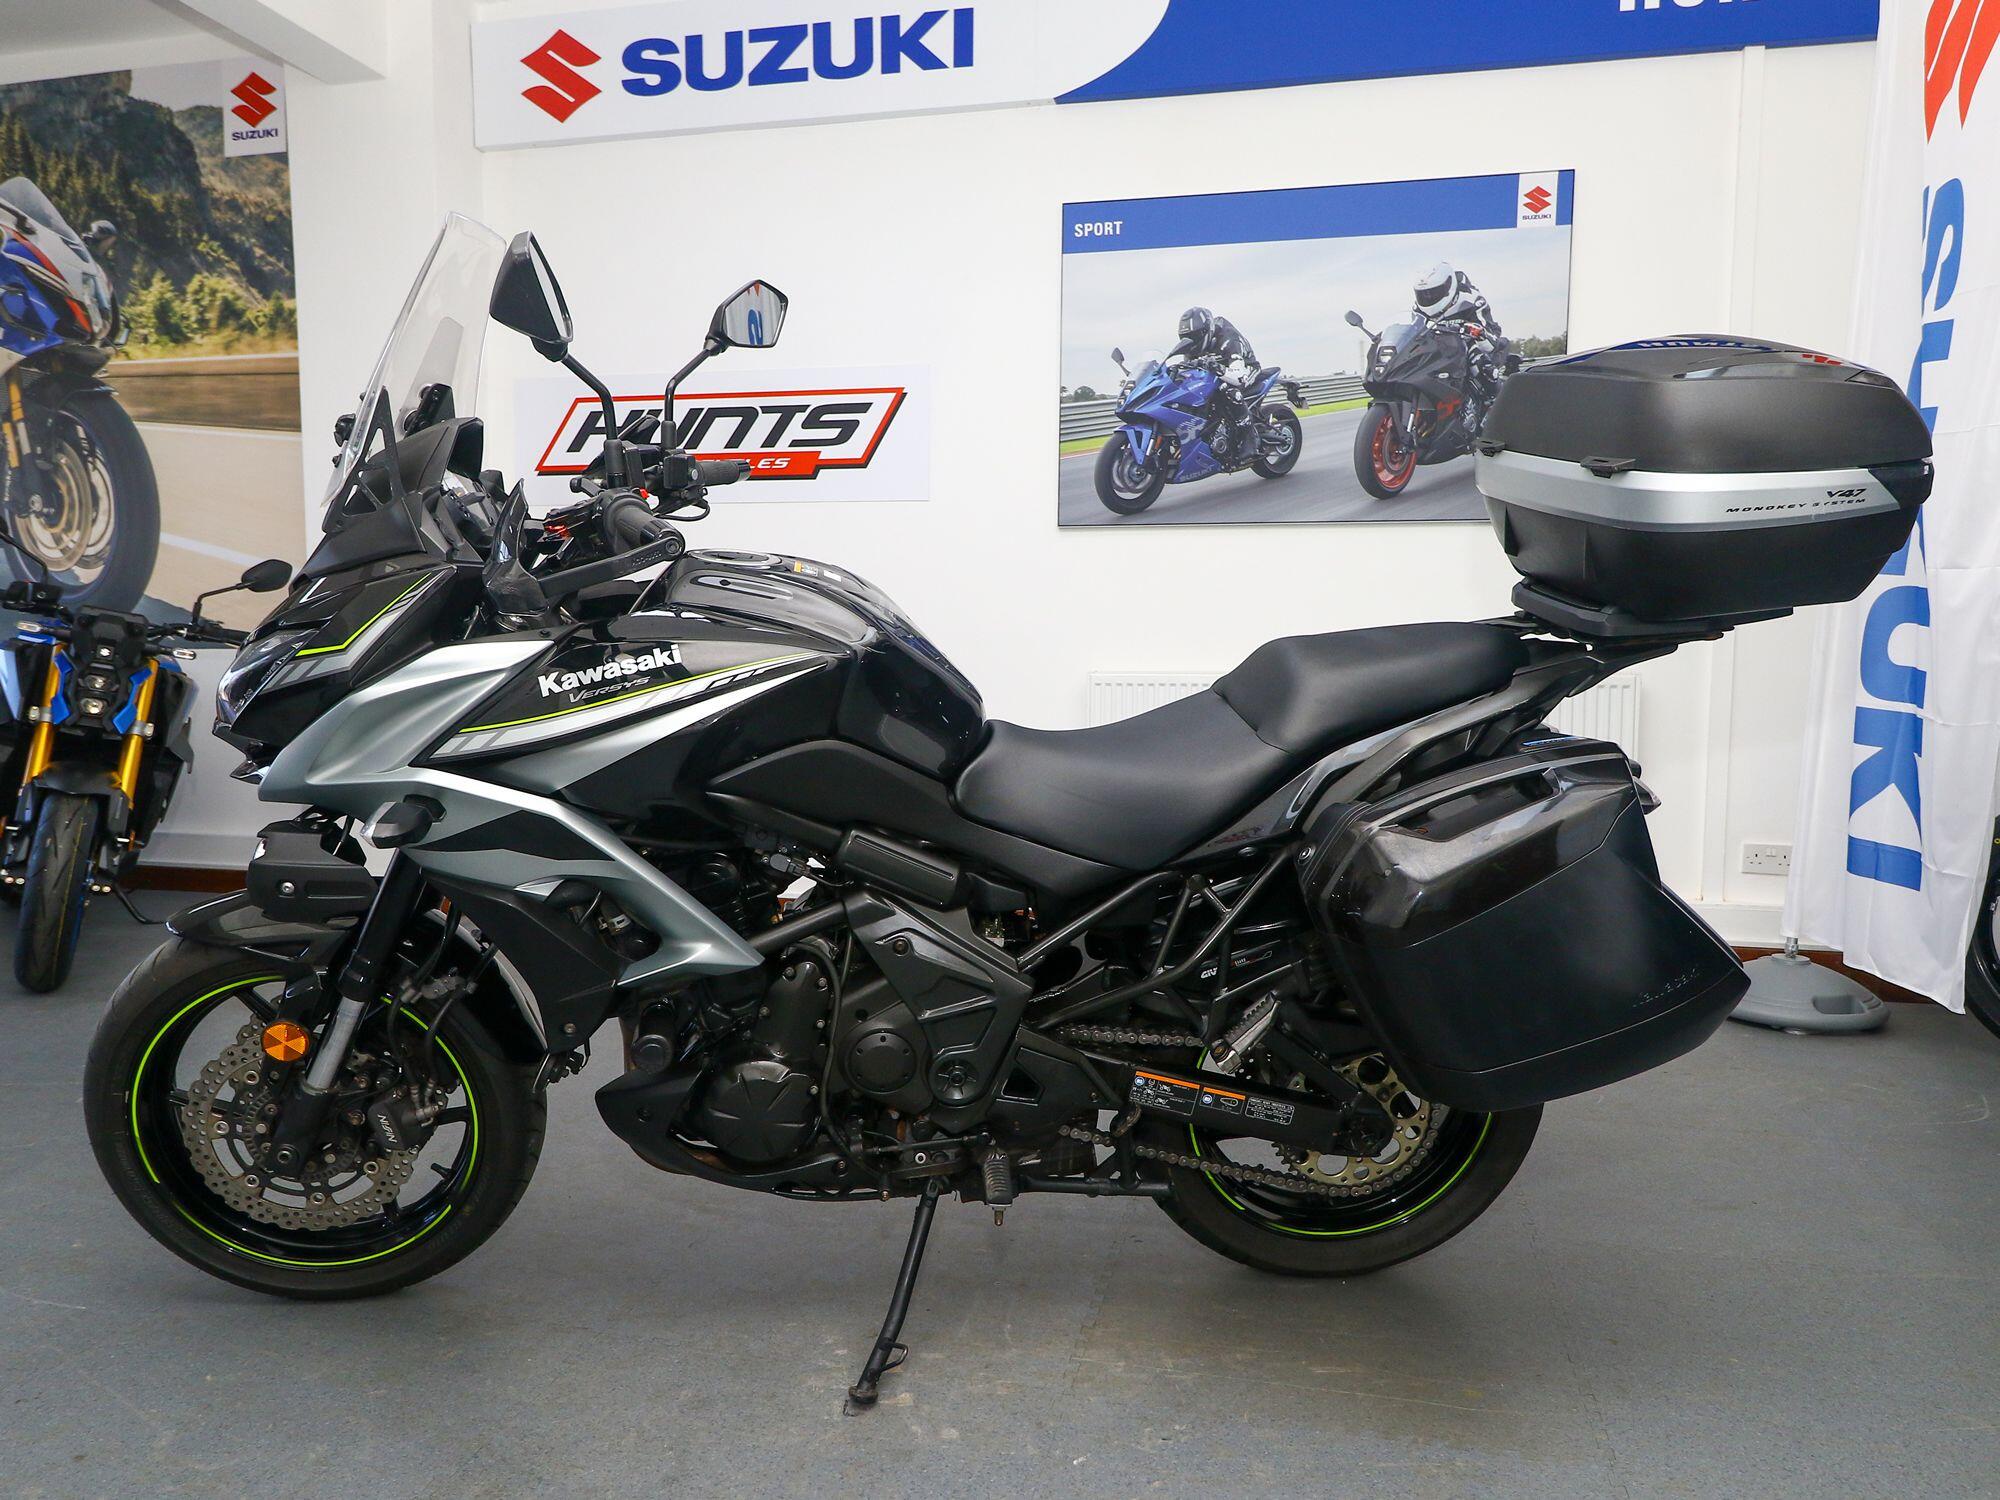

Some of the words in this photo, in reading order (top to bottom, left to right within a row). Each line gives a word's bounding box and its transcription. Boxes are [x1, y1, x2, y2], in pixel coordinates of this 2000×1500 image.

[621, 7, 974, 97] SUZUKI
[232, 128, 278, 141] SUZUKI
[1522, 213, 1552, 221] SUZUKI
[1074, 221, 1123, 238] SPORT
[1826, 488, 1867, 499] V47
[1726, 503, 1807, 513] MONOKEY
[537, 643, 683, 698] Kawasaki
[569, 676, 651, 703] VERSYS
[1200, 966, 1219, 979] GIV
